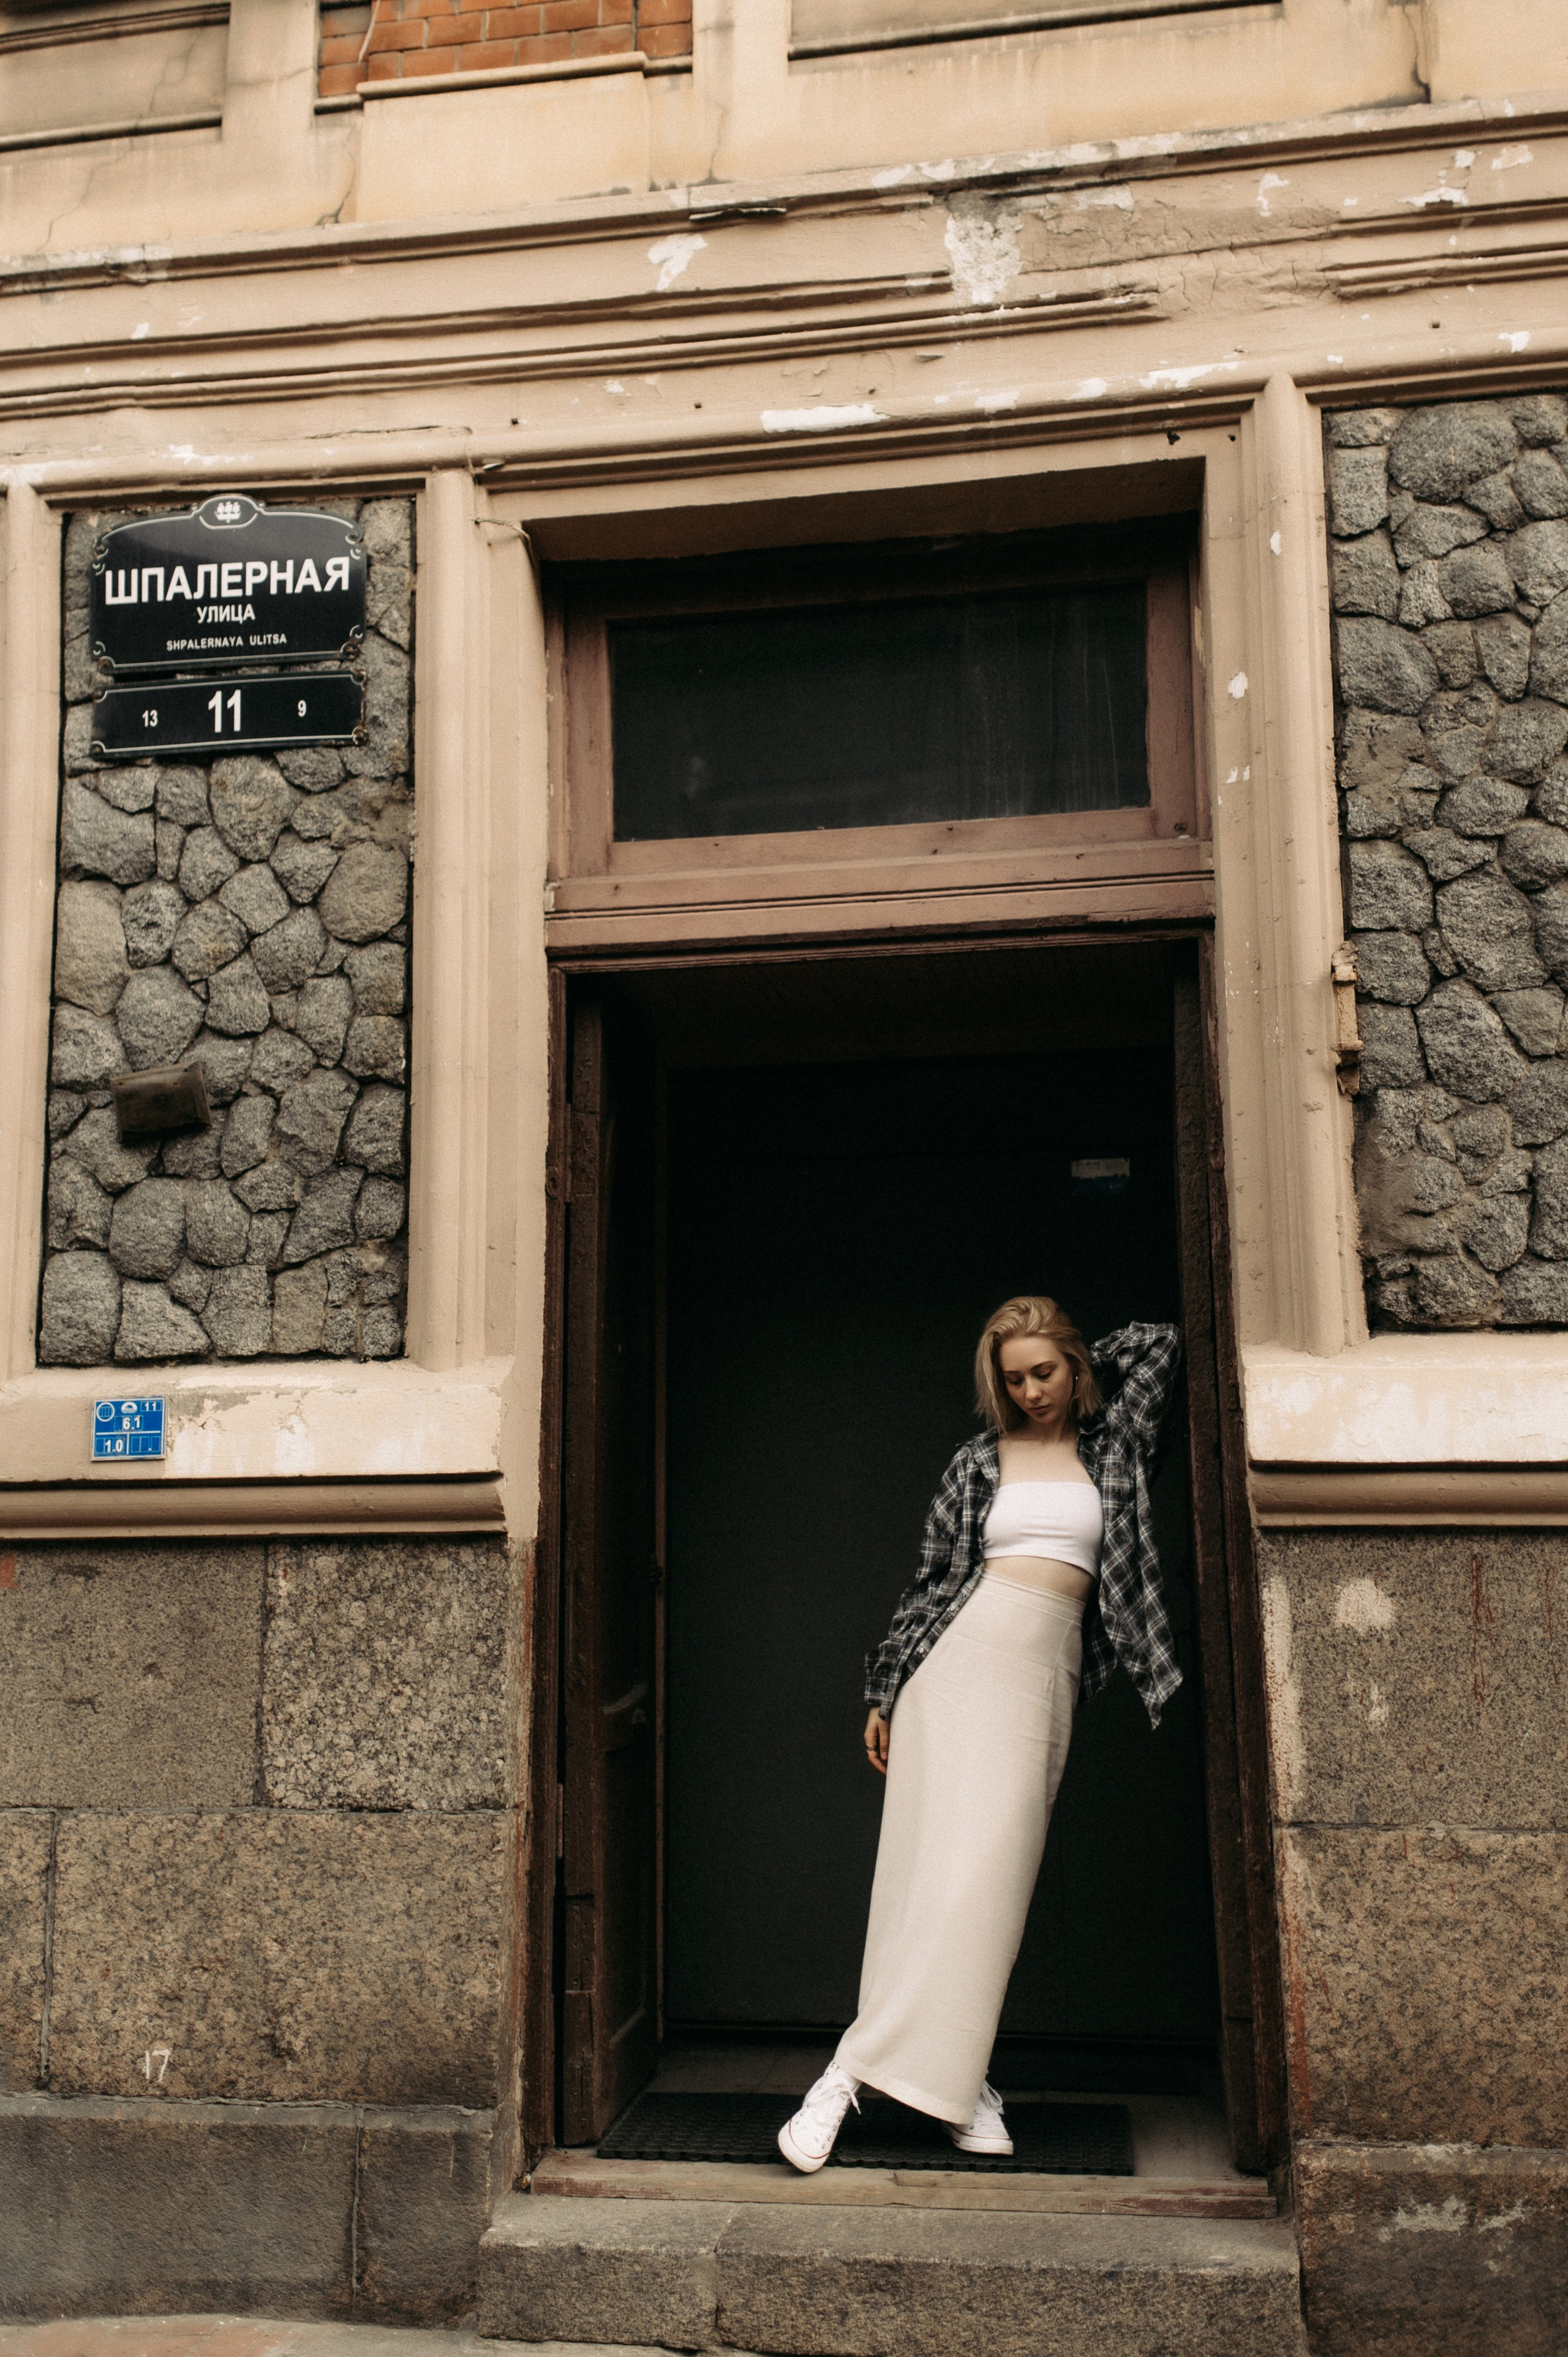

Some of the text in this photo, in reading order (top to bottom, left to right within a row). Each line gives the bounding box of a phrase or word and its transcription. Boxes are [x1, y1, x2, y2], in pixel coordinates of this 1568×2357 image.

[104, 555, 351, 606] ШПАЛЕРНАЯ
[196, 603, 256, 624] УЛИЦА
[166, 633, 287, 652] SHPALERNAYA ULITSA
[141, 709, 159, 728] 13
[207, 688, 242, 733] 11
[296, 700, 307, 718] 9
[145, 1401, 156, 1411] 11
[123, 1415, 140, 1430] 6.1
[105, 1439, 123, 1453] 1.0
